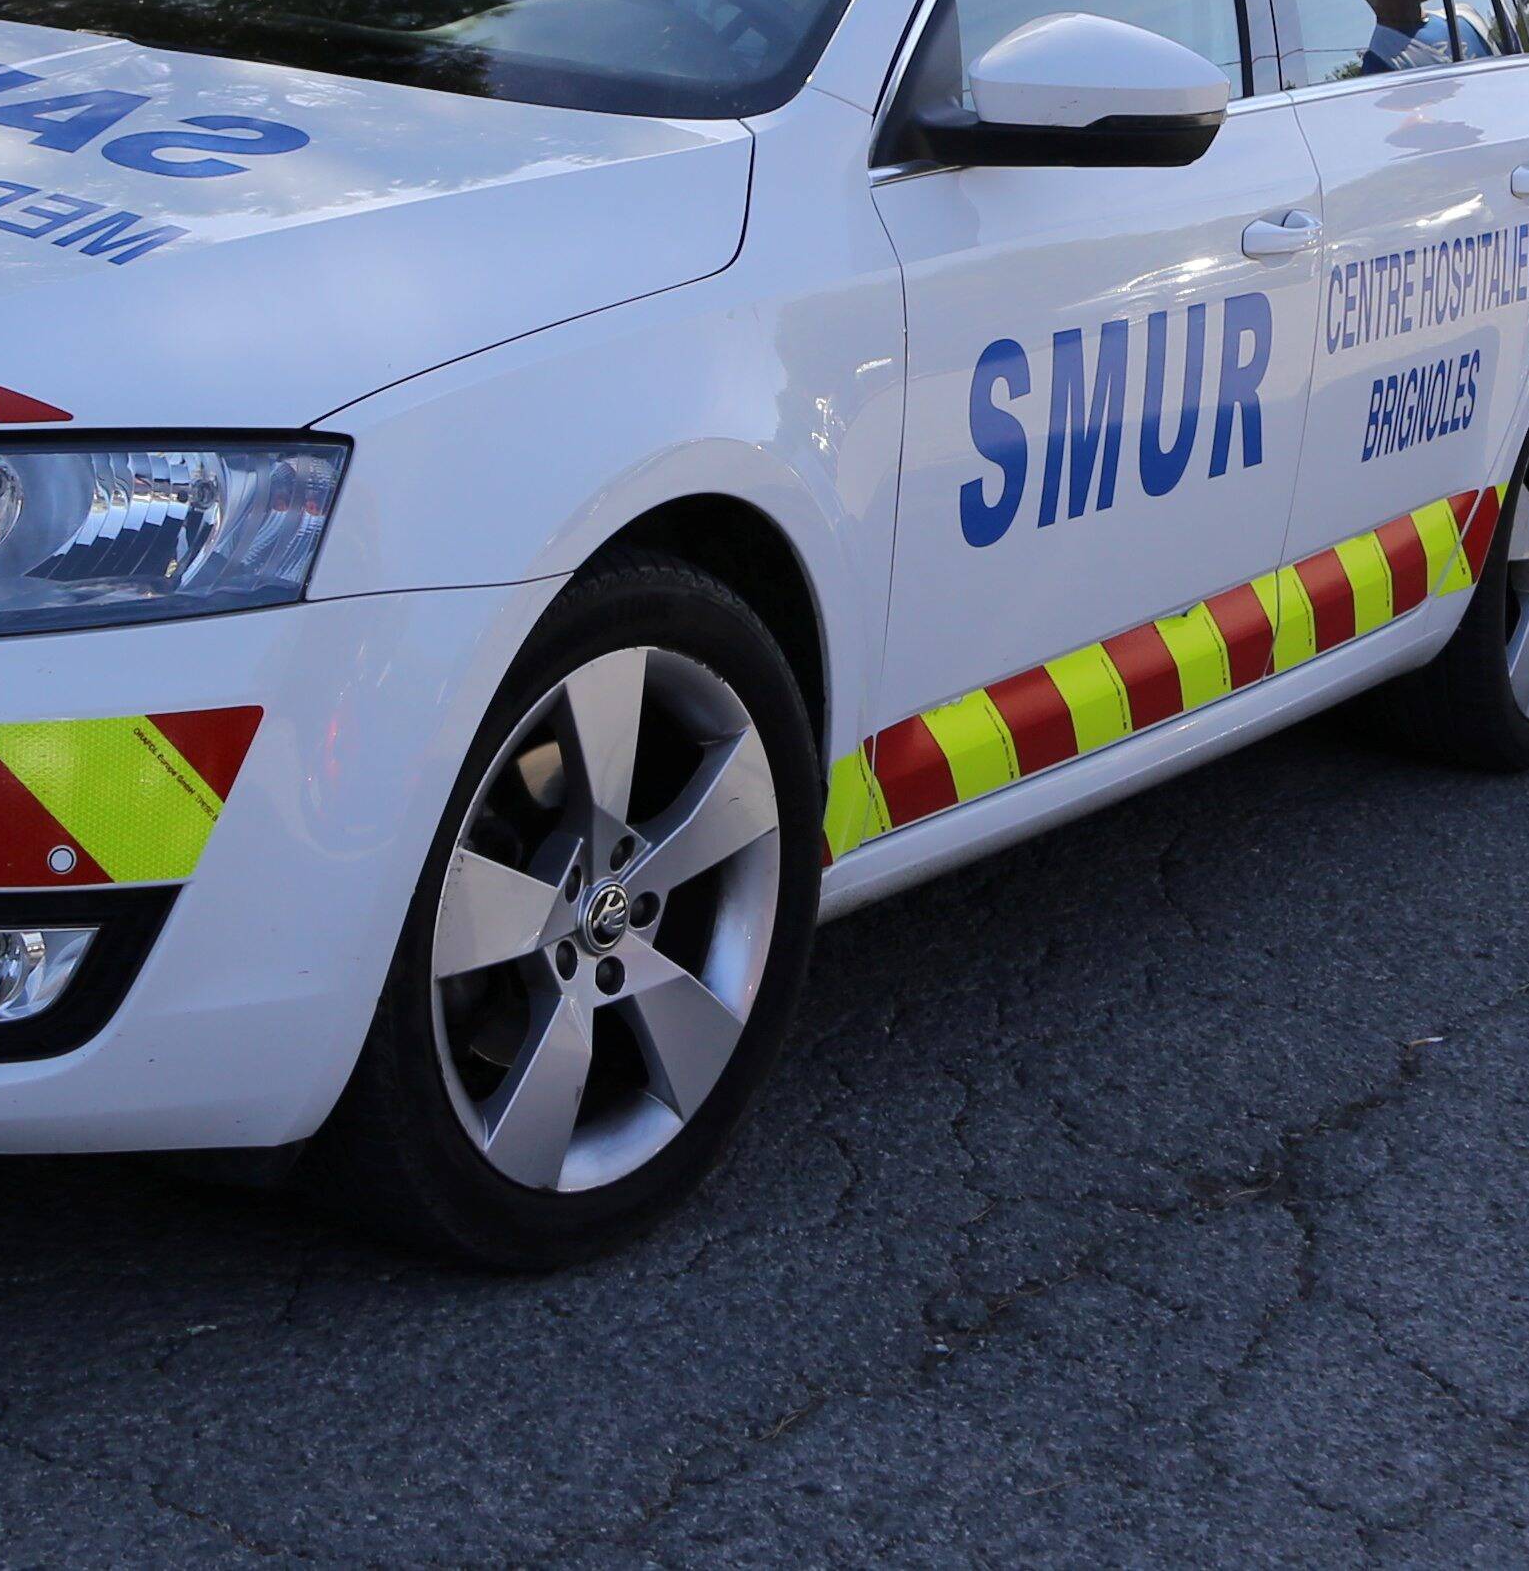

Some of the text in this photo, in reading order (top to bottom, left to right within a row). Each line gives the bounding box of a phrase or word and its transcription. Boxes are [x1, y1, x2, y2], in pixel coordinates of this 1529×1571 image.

[1325, 248, 1417, 356] CENTRE
[960, 291, 1273, 549] SMUR
[1361, 348, 1481, 464] BRIGNOLES
